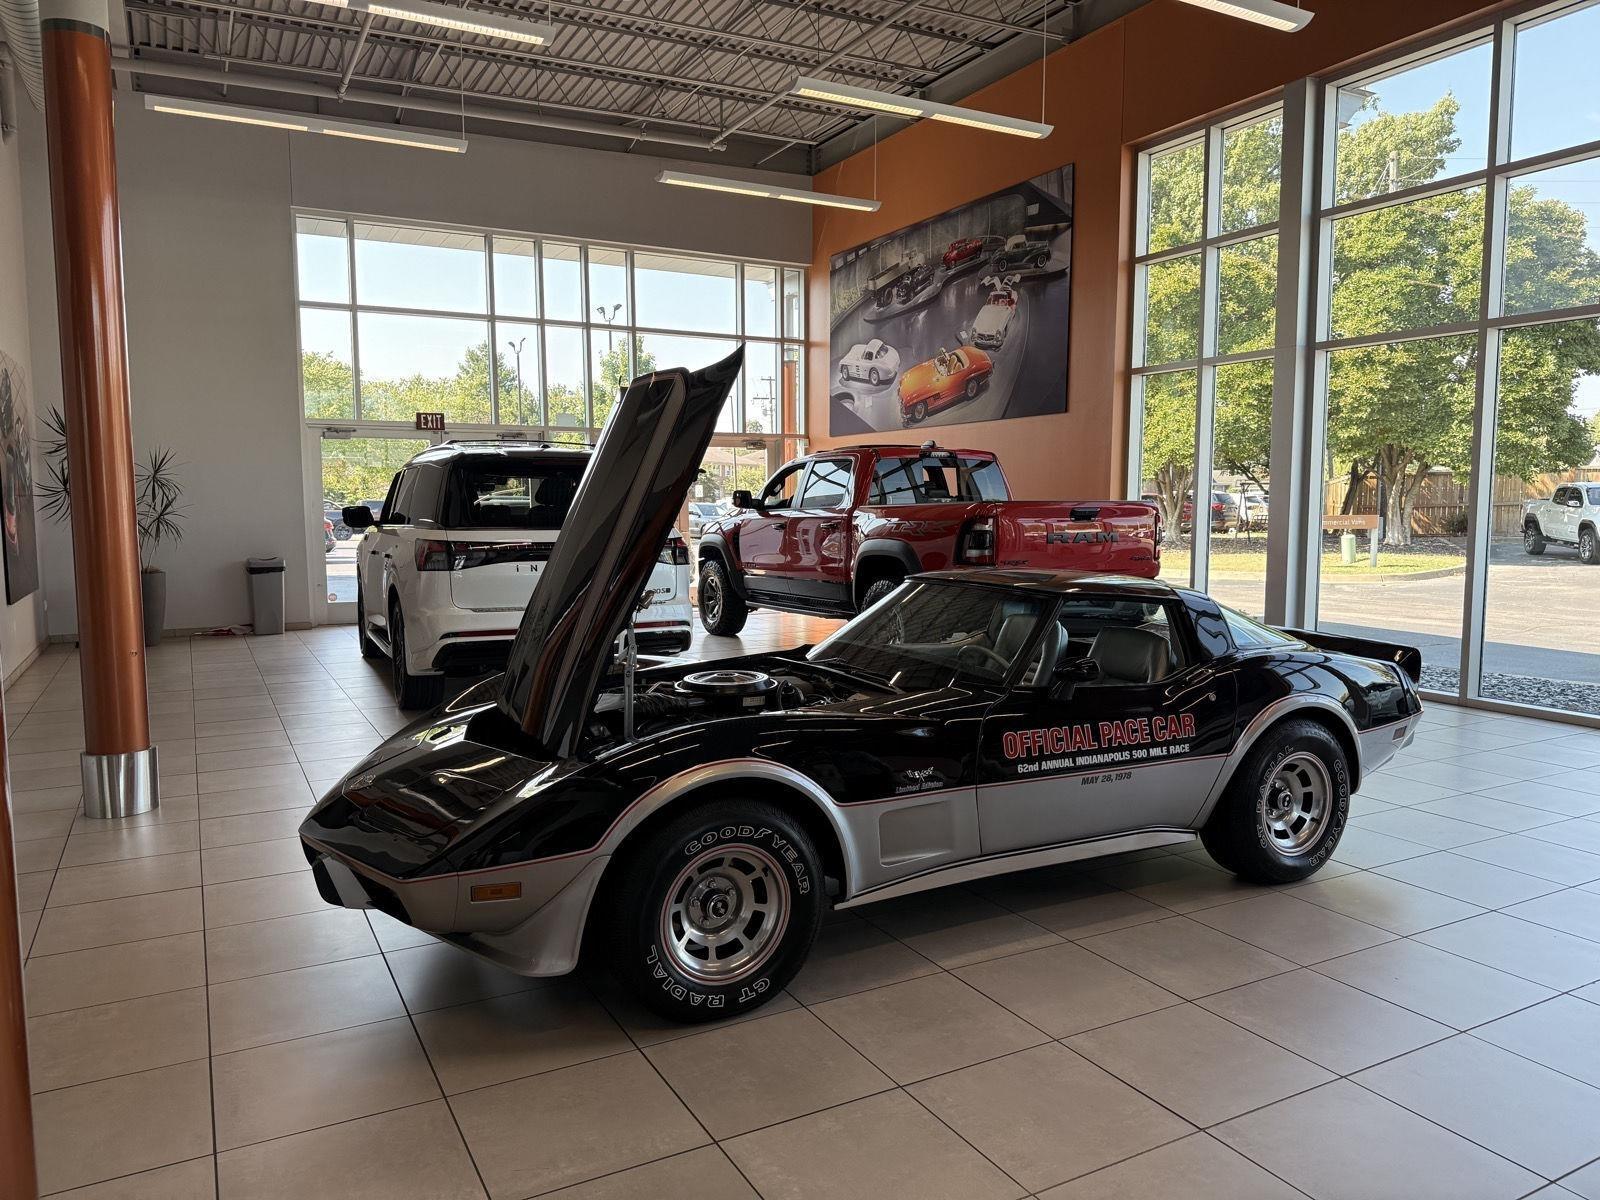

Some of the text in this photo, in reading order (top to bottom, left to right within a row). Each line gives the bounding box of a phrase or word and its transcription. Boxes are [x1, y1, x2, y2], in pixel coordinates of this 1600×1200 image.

[421, 414, 441, 429] EXIT
[1046, 531, 1119, 545] RAM
[1003, 713, 1196, 759] OFFICIAL PACE CAR
[1017, 744, 1190, 773] 62nd ANNUAL INDIANAPOLIS 500 MILE RACE
[1081, 771, 1132, 786] MAY 28, 1978
[1309, 759, 1348, 867] GOODYEAR
[685, 826, 809, 895] GOODYEAR
[646, 945, 770, 1008] GT RADIAL
